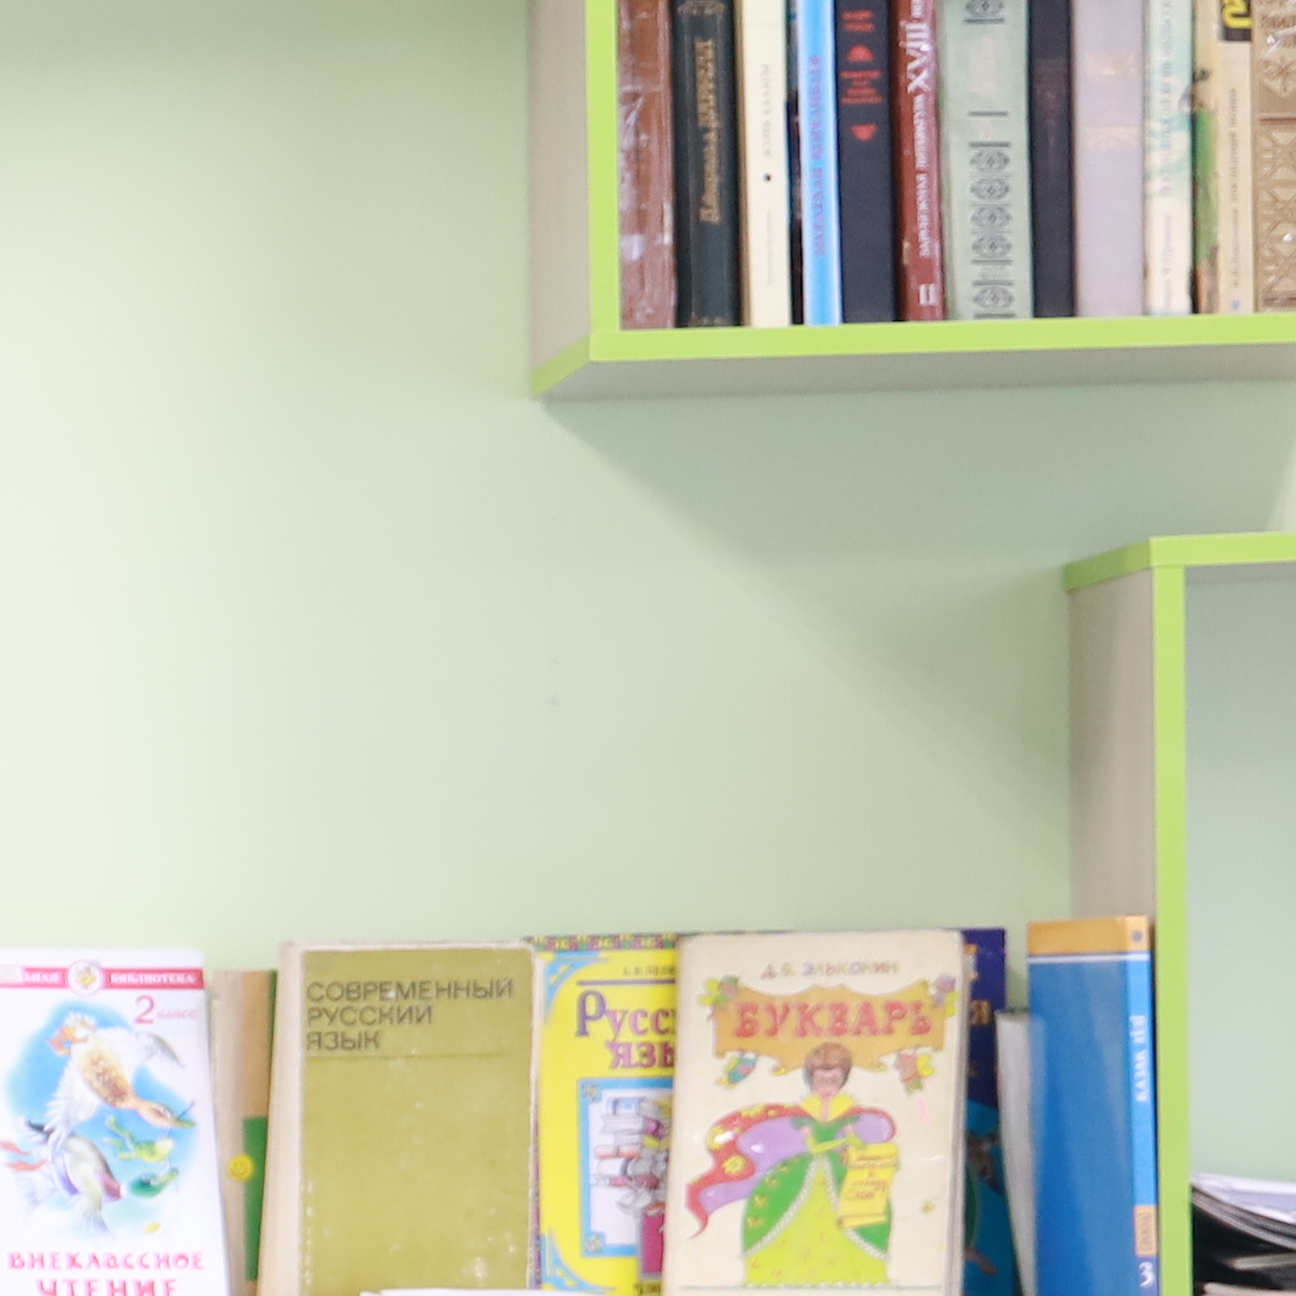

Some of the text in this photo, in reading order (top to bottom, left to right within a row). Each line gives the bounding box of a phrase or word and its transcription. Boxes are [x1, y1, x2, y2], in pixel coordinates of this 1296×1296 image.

[308, 979, 513, 1001] СОВРЕМЕННЫЙ
[134, 995, 156, 1024] 2
[308, 1005, 433, 1027] РУССКИЙ
[735, 1001, 933, 1039] БУКВАРЬ
[307, 1030, 380, 1050] ЯЗЫК
[9, 1252, 203, 1271] ВНЕКЛАССНОЕ
[1138, 1260, 1156, 1288] 3
